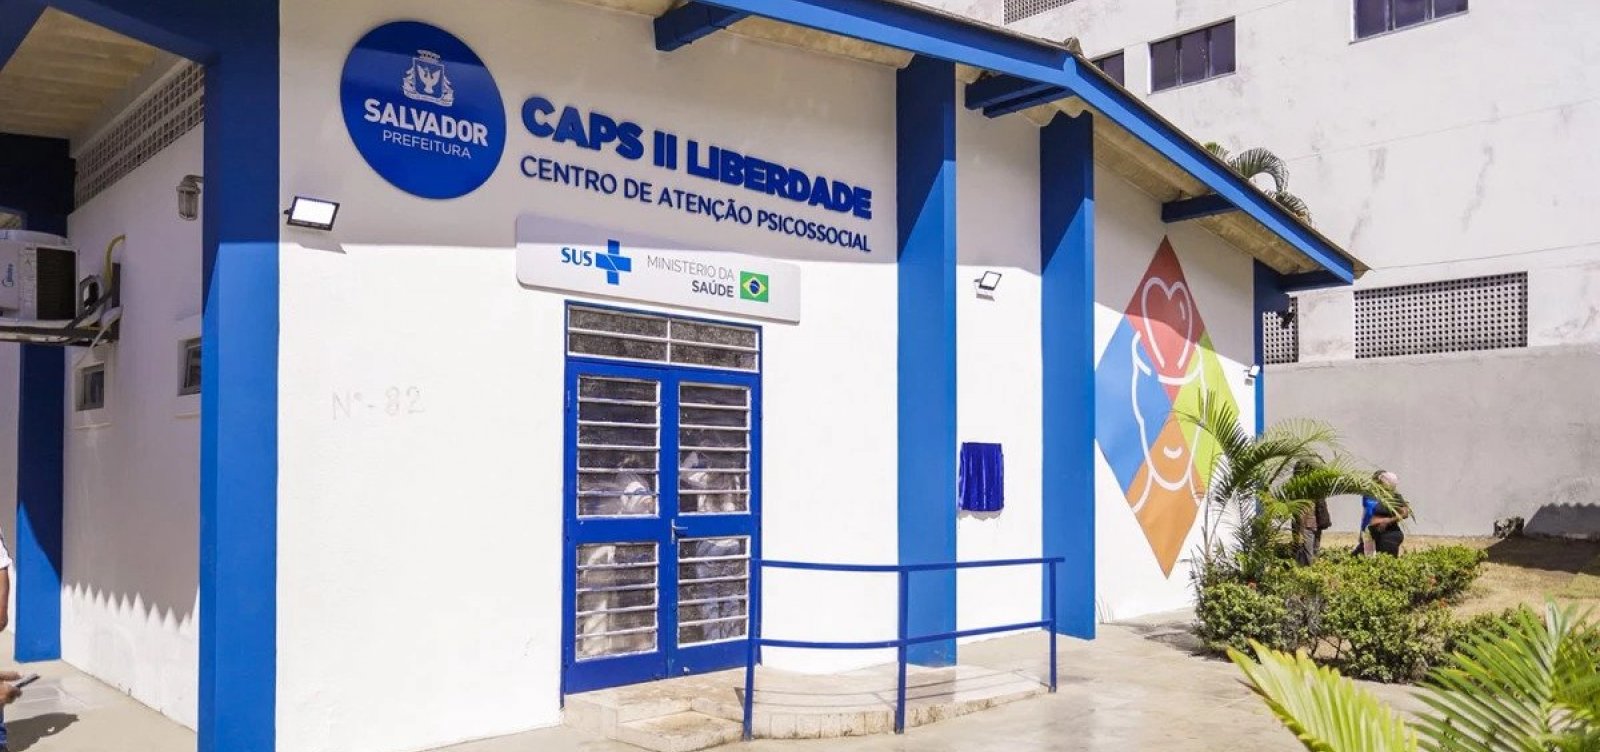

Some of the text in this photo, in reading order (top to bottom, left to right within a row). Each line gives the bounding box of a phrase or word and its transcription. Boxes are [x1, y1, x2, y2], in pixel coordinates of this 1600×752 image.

[364, 98, 489, 147] SALVADOR
[382, 130, 472, 159] PREFEITURA
[521, 96, 872, 219] CAPS II LIBERDADE
[520, 155, 872, 252] CENTRO DE ATENÇÃO PSICOSSOCIAL
[561, 247, 592, 267] SUS
[646, 255, 735, 282] MINISTÉRIO DA
[691, 279, 735, 298] SAÚDE
